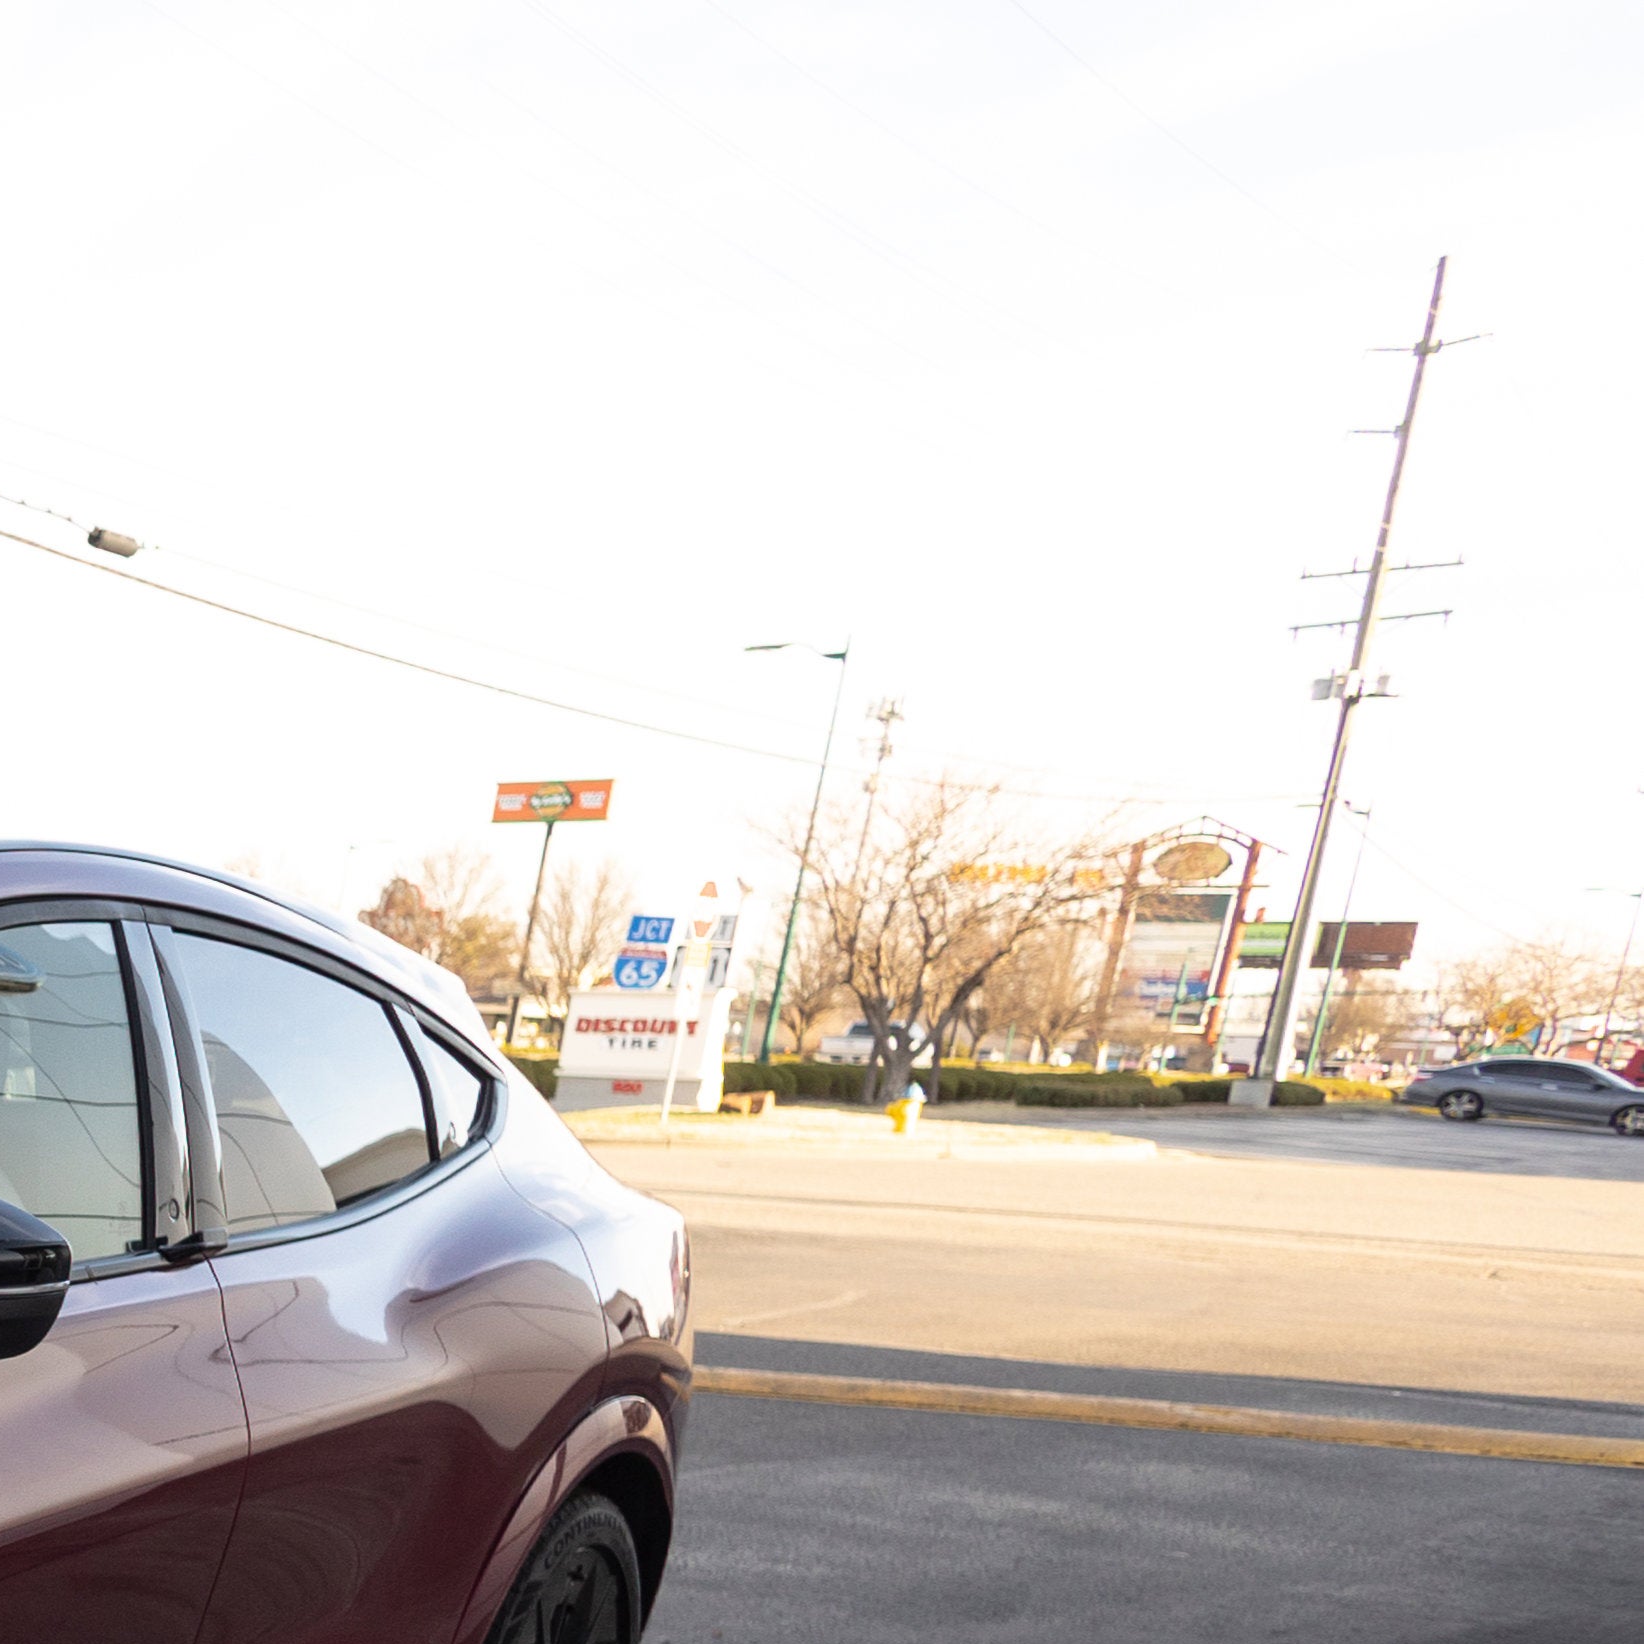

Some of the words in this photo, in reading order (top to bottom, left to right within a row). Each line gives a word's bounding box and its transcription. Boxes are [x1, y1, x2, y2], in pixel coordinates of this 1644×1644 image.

[632, 918, 671, 941] JCT
[620, 960, 660, 986] 65
[575, 1017, 698, 1035] DISCOUNT
[608, 1037, 659, 1049] TIRE
